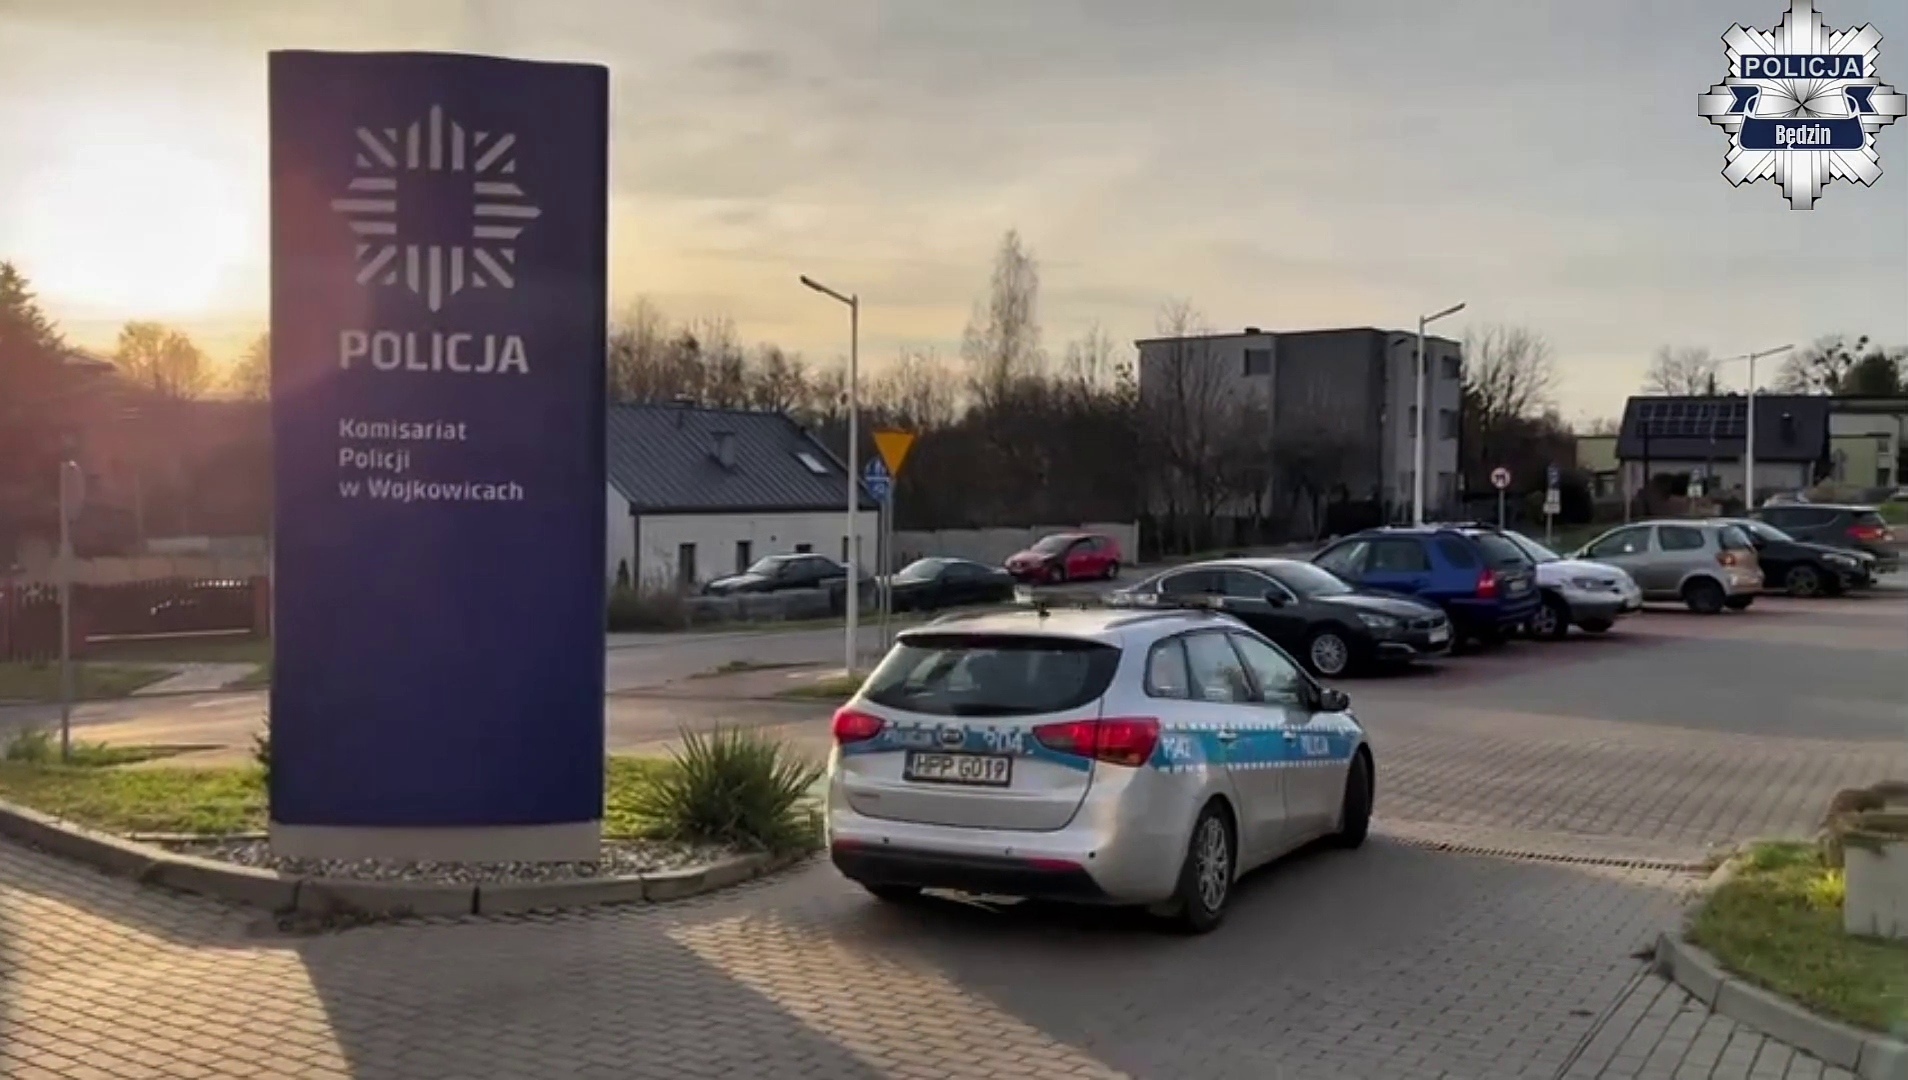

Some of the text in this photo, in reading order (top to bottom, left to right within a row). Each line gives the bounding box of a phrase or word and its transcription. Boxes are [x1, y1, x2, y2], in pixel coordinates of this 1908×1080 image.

[339, 330, 529, 374] POLICJA
[338, 418, 467, 440] Komisariat
[338, 447, 411, 473] Policji
[339, 477, 524, 502] w Wojkowicach
[915, 754, 955, 776] HPP
